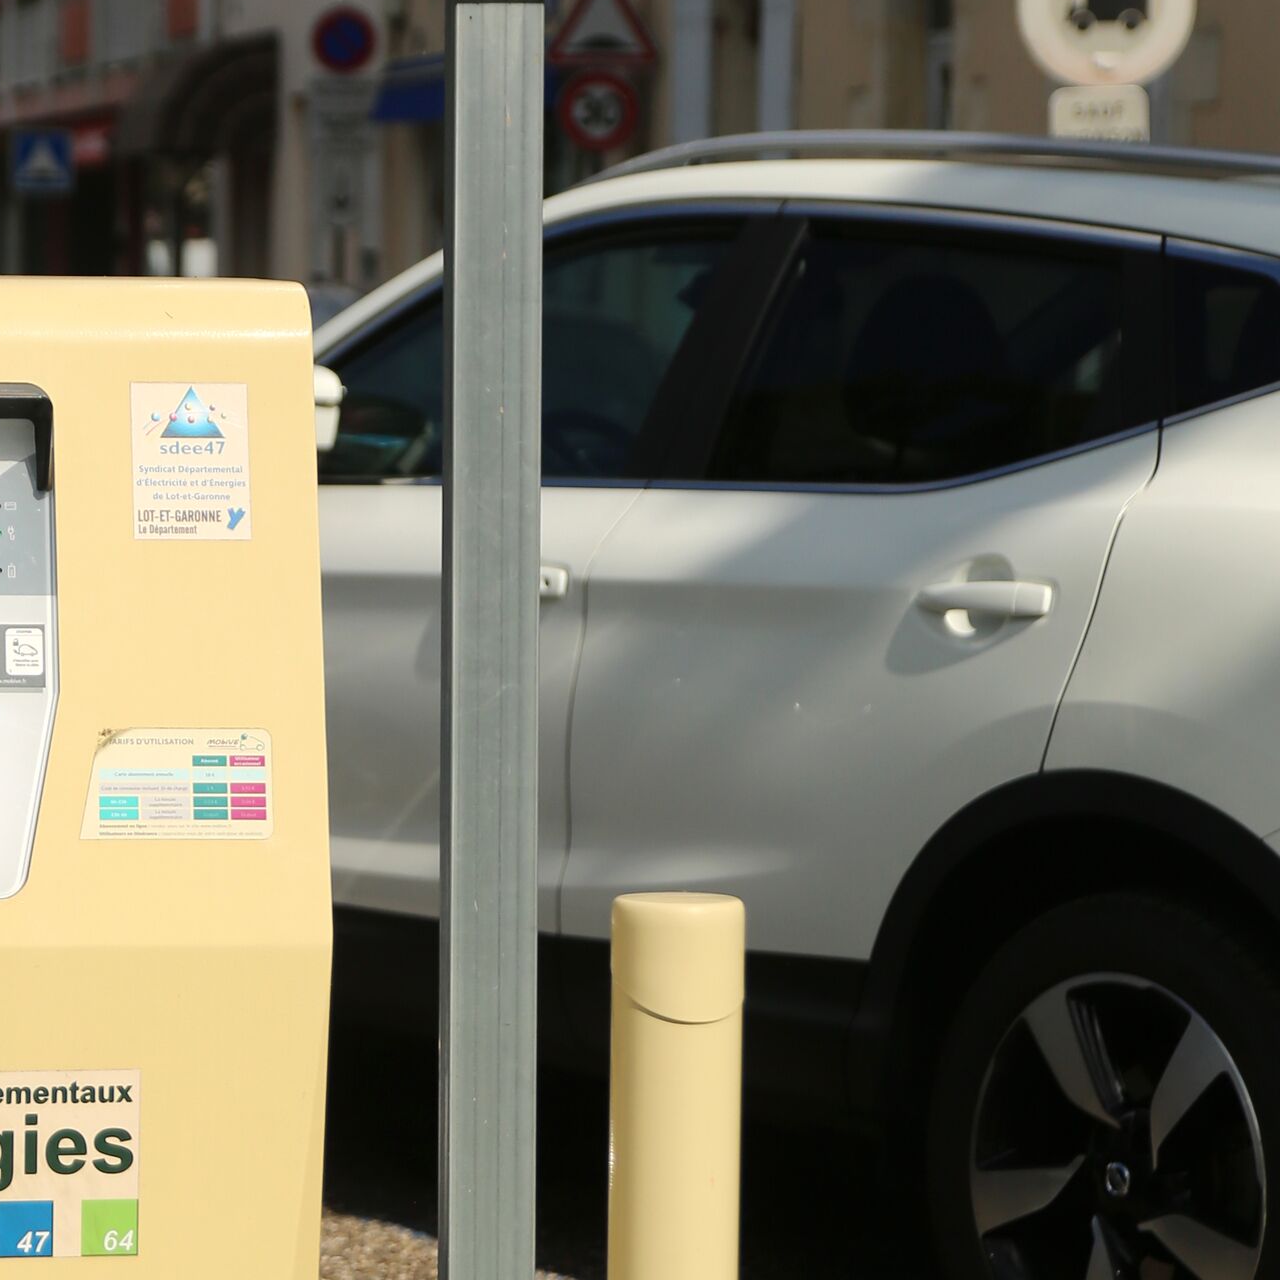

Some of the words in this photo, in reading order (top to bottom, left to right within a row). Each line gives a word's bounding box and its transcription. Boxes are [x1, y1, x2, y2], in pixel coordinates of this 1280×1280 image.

[160, 441, 225, 455] sdee47
[138, 465, 176, 475] Syndicat
[178, 465, 243, 475] Départemental
[190, 478, 198, 487] et
[153, 492, 163, 500] de
[166, 492, 231, 501] Lot-et-Garonne
[137, 509, 222, 523] LOT-ET-GARONNE
[138, 524, 147, 534] Le
[149, 523, 198, 536] Département
[136, 738, 194, 746] D'UTILISATION
[17, 1231, 50, 1254] 47
[103, 1229, 134, 1253] 64
